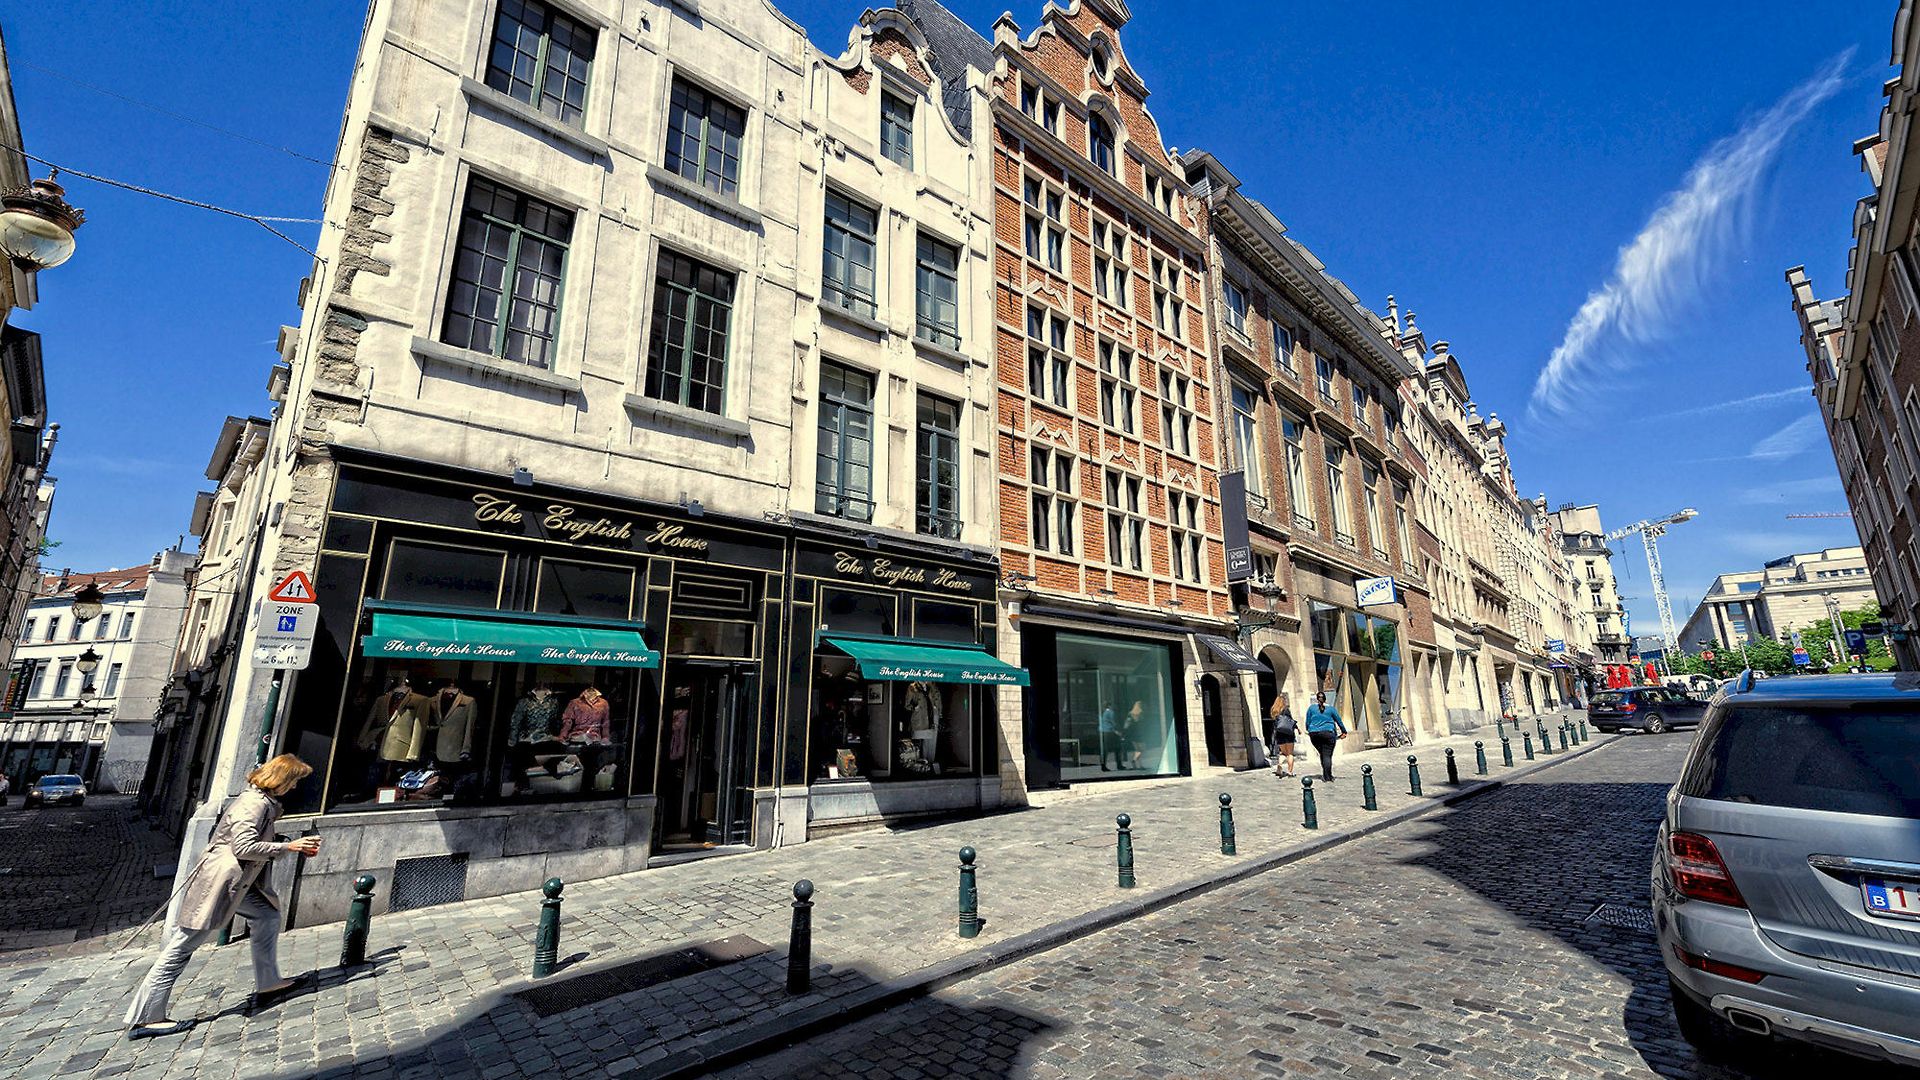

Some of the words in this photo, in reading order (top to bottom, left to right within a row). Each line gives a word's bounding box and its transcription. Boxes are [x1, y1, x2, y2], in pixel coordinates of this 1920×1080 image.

[473, 493, 522, 524] The
[543, 505, 633, 540] English
[645, 521, 709, 550] House
[835, 551, 864, 575] The
[872, 558, 925, 585] English
[931, 568, 972, 591] House
[276, 605, 304, 615] ZONE
[1846, 632, 1861, 646] P
[384, 640, 413, 651] The
[415, 641, 470, 657] English
[473, 645, 516, 656] House
[541, 647, 564, 658] The
[566, 649, 610, 663] English
[613, 652, 648, 662] House
[879, 666, 894, 676] The
[895, 667, 921, 679] English
[922, 669, 944, 679] House
[961, 670, 974, 680] The
[974, 671, 997, 682] English
[997, 673, 1016, 681] House
[1873, 895, 1886, 907] B
